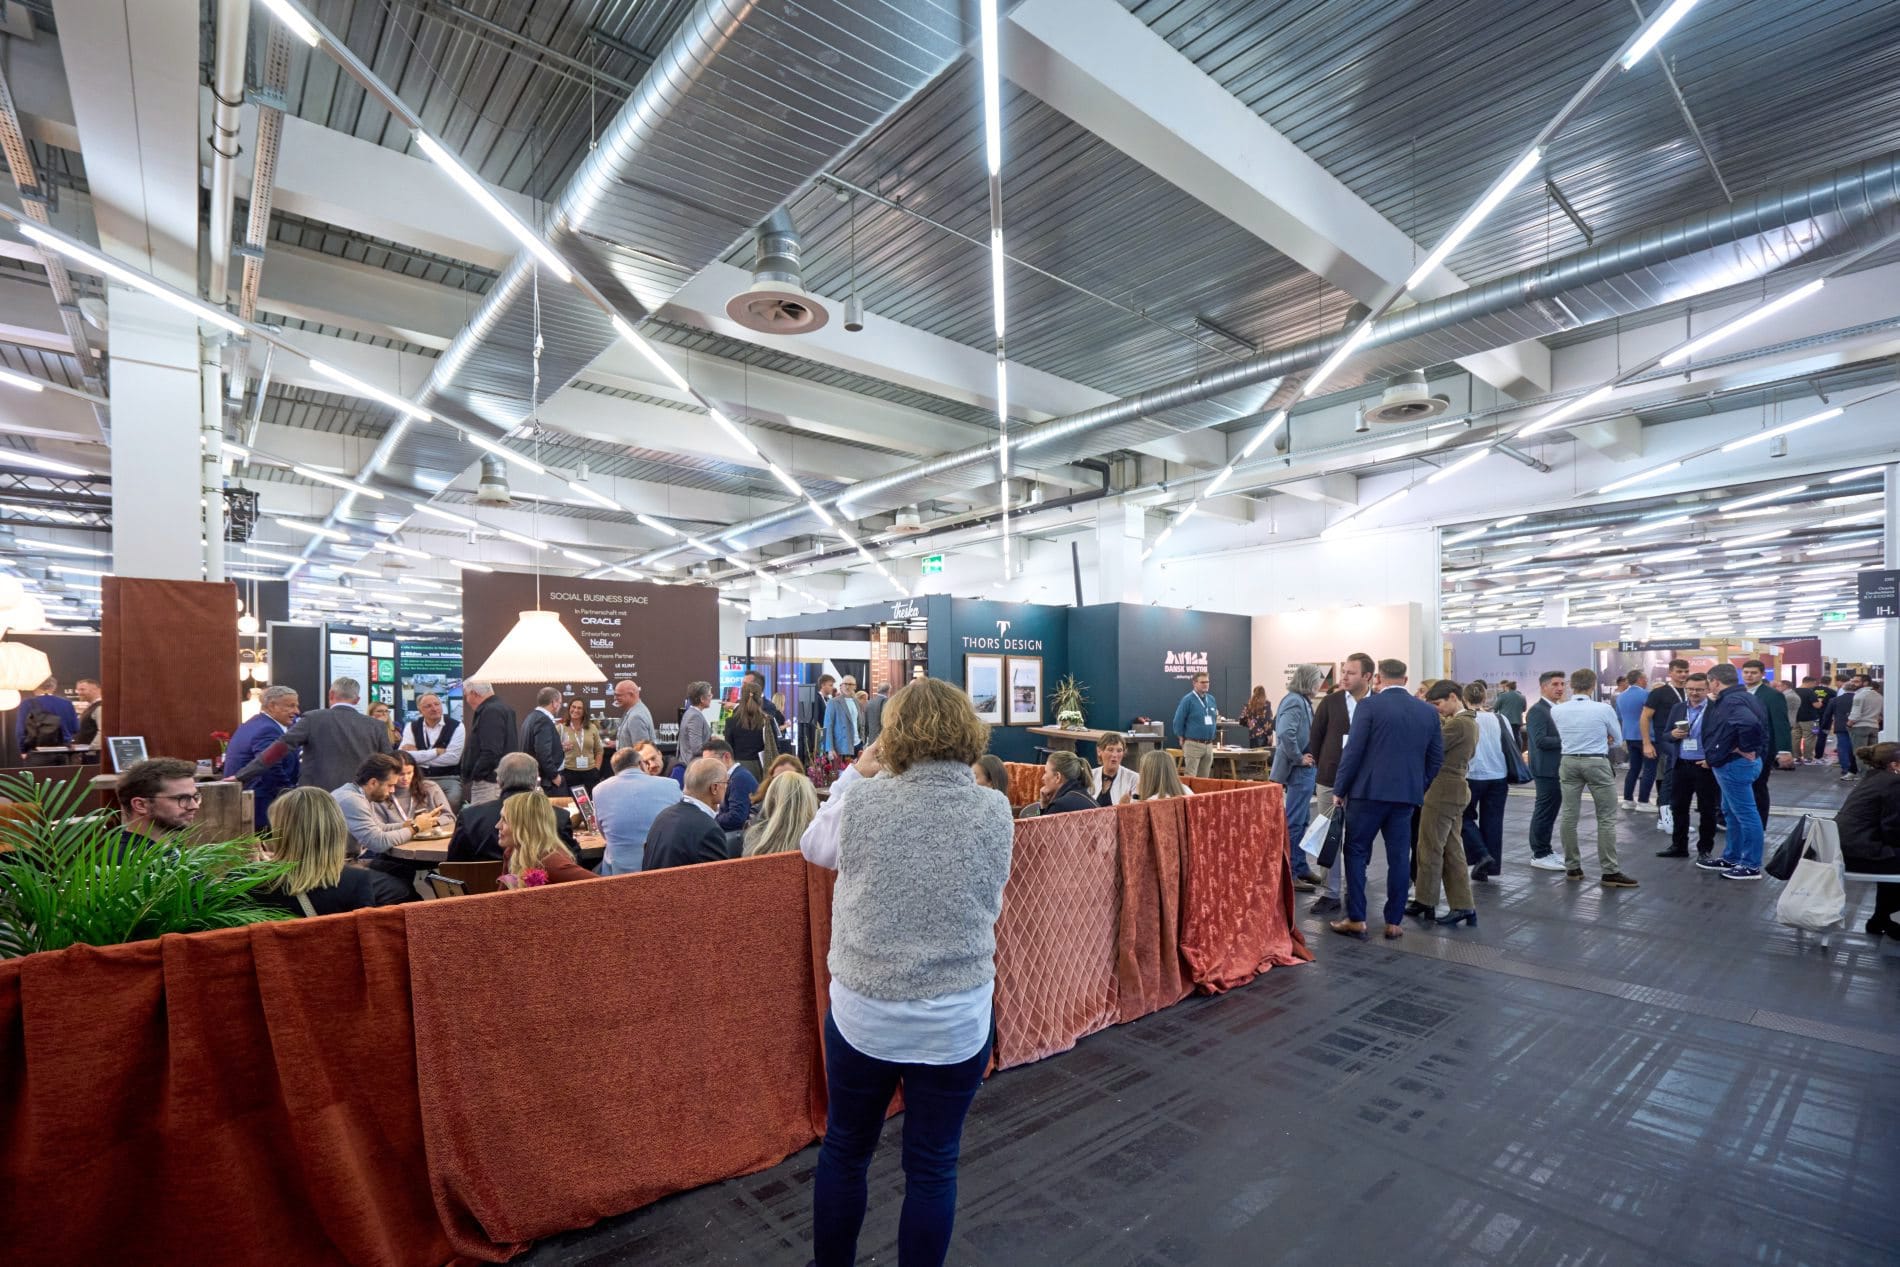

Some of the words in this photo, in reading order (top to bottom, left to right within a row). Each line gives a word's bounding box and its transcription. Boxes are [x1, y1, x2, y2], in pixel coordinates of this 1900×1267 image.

[550, 592, 581, 601] SOCIAL
[583, 594, 622, 603] BUSINESS
[624, 596, 648, 604] SPACE
[581, 617, 621, 625] ORACLE
[962, 637, 1000, 649] THORS
[1004, 640, 1042, 650] DESIGN
[1164, 665, 1185, 673] DANSK
[1186, 665, 1208, 673] WILTON
